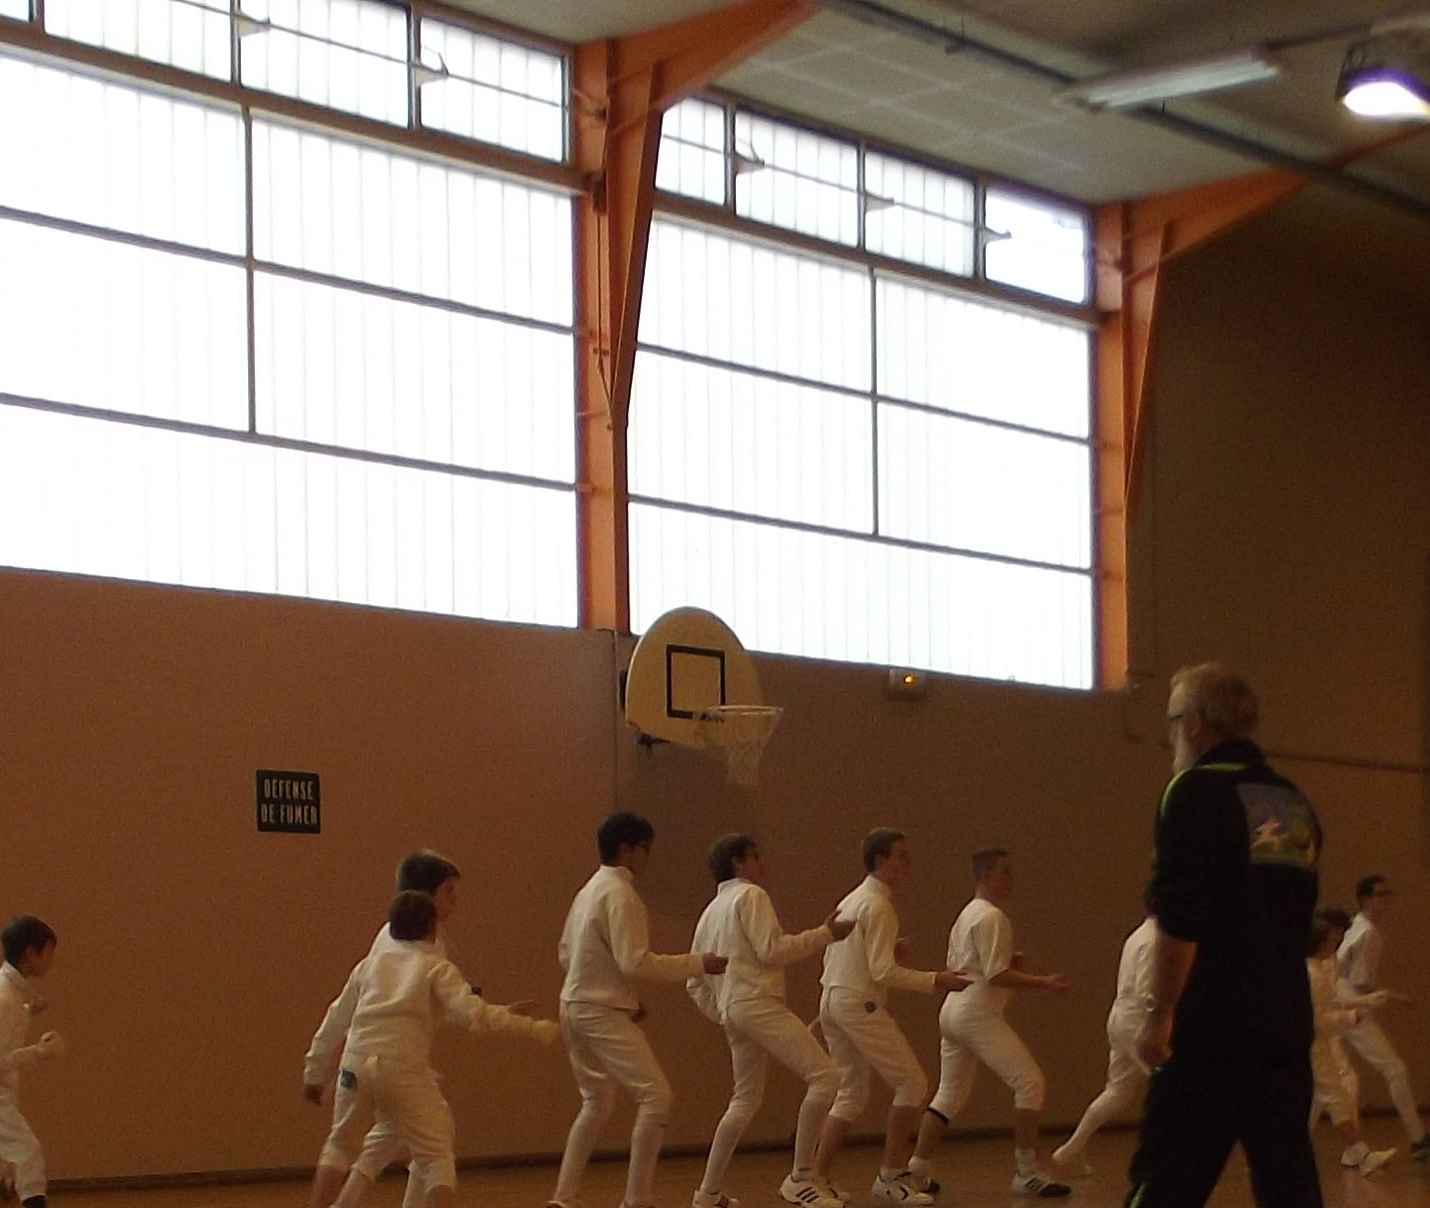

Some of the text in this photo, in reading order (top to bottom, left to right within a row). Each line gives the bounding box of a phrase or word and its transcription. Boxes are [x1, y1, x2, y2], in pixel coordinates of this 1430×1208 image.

[264, 779, 313, 800] DEFENSE
[261, 803, 317, 824] DE FUMER
